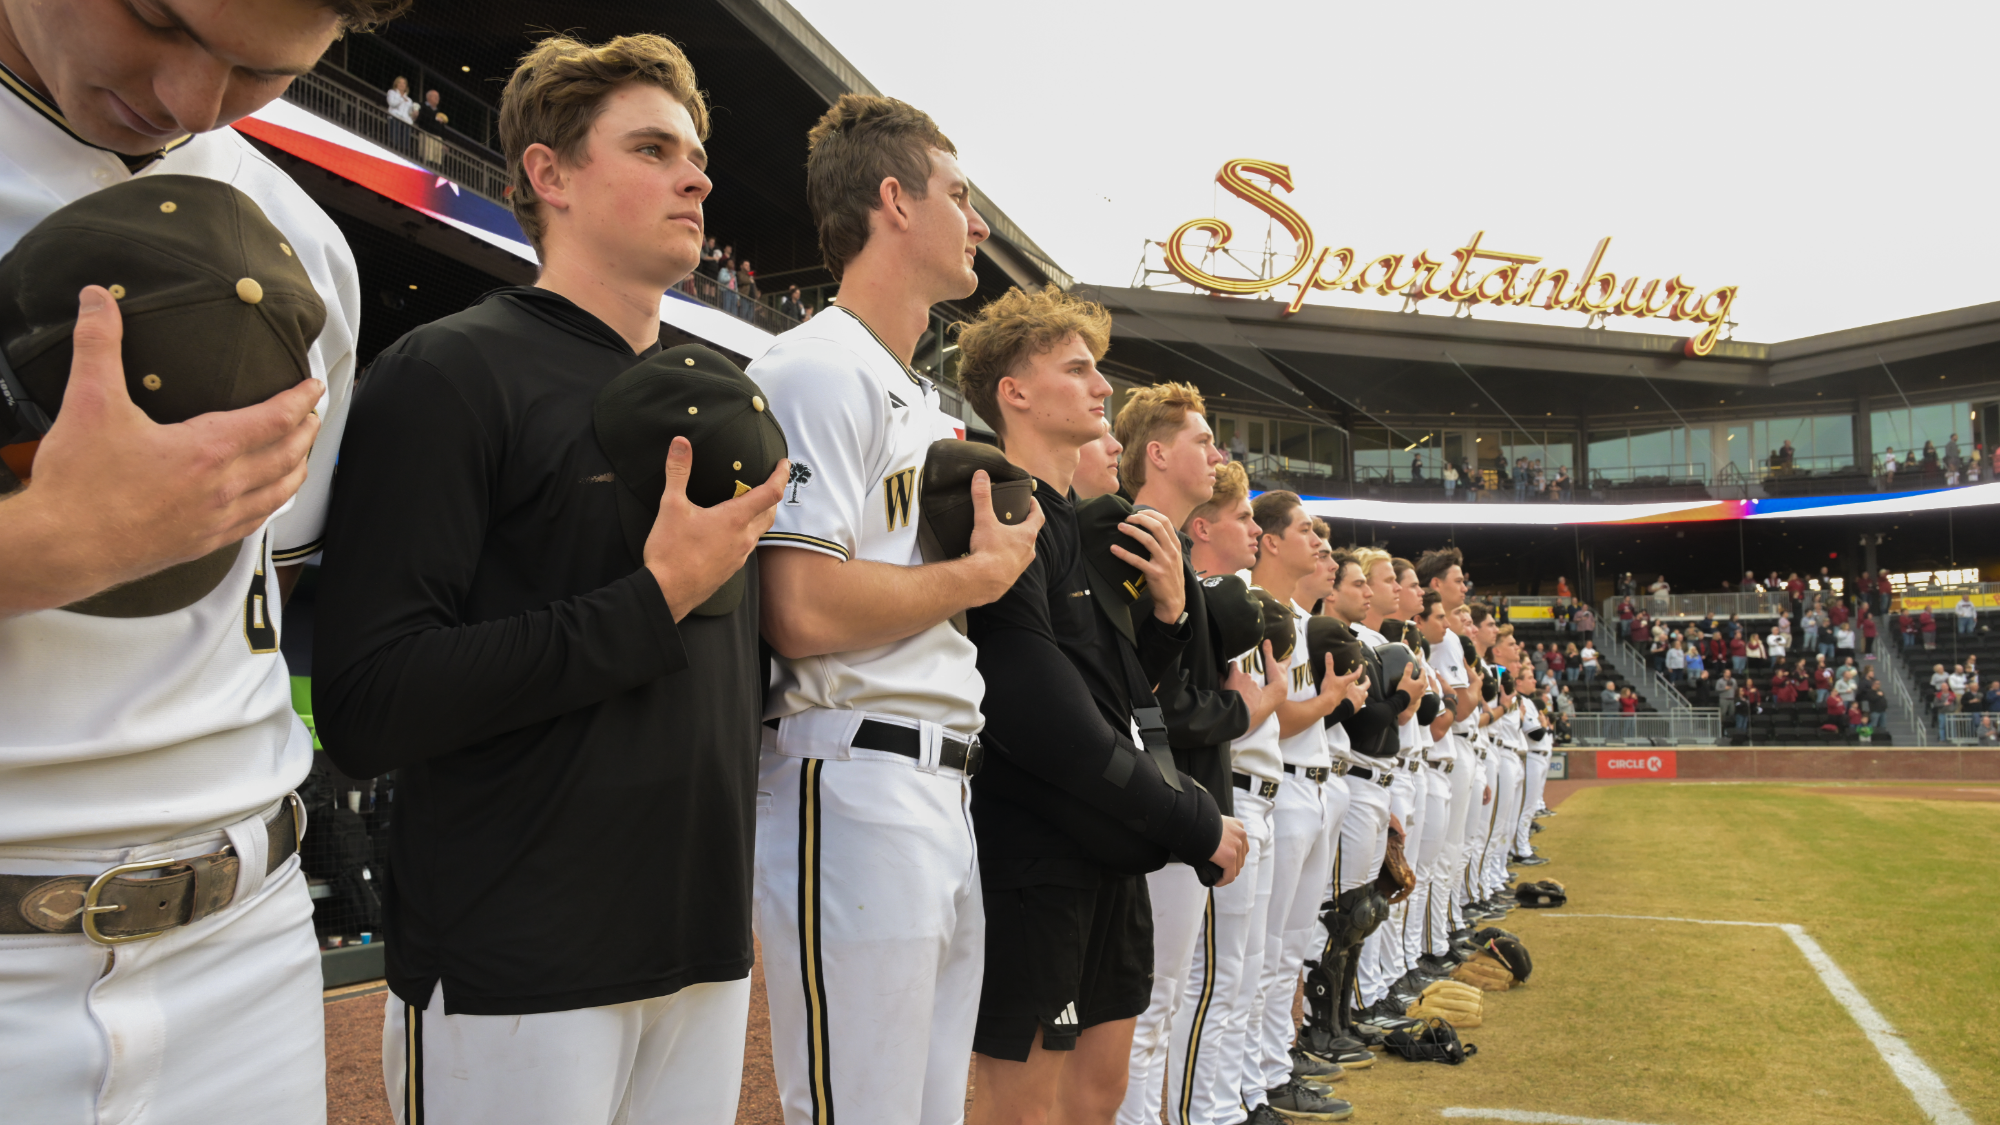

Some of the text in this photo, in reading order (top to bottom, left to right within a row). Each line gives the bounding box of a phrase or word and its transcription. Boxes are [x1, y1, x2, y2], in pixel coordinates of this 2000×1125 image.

[1165, 158, 1739, 356] Spartanburg
[883, 466, 924, 532] W
[1607, 757, 1662, 771] CIRCLE K
